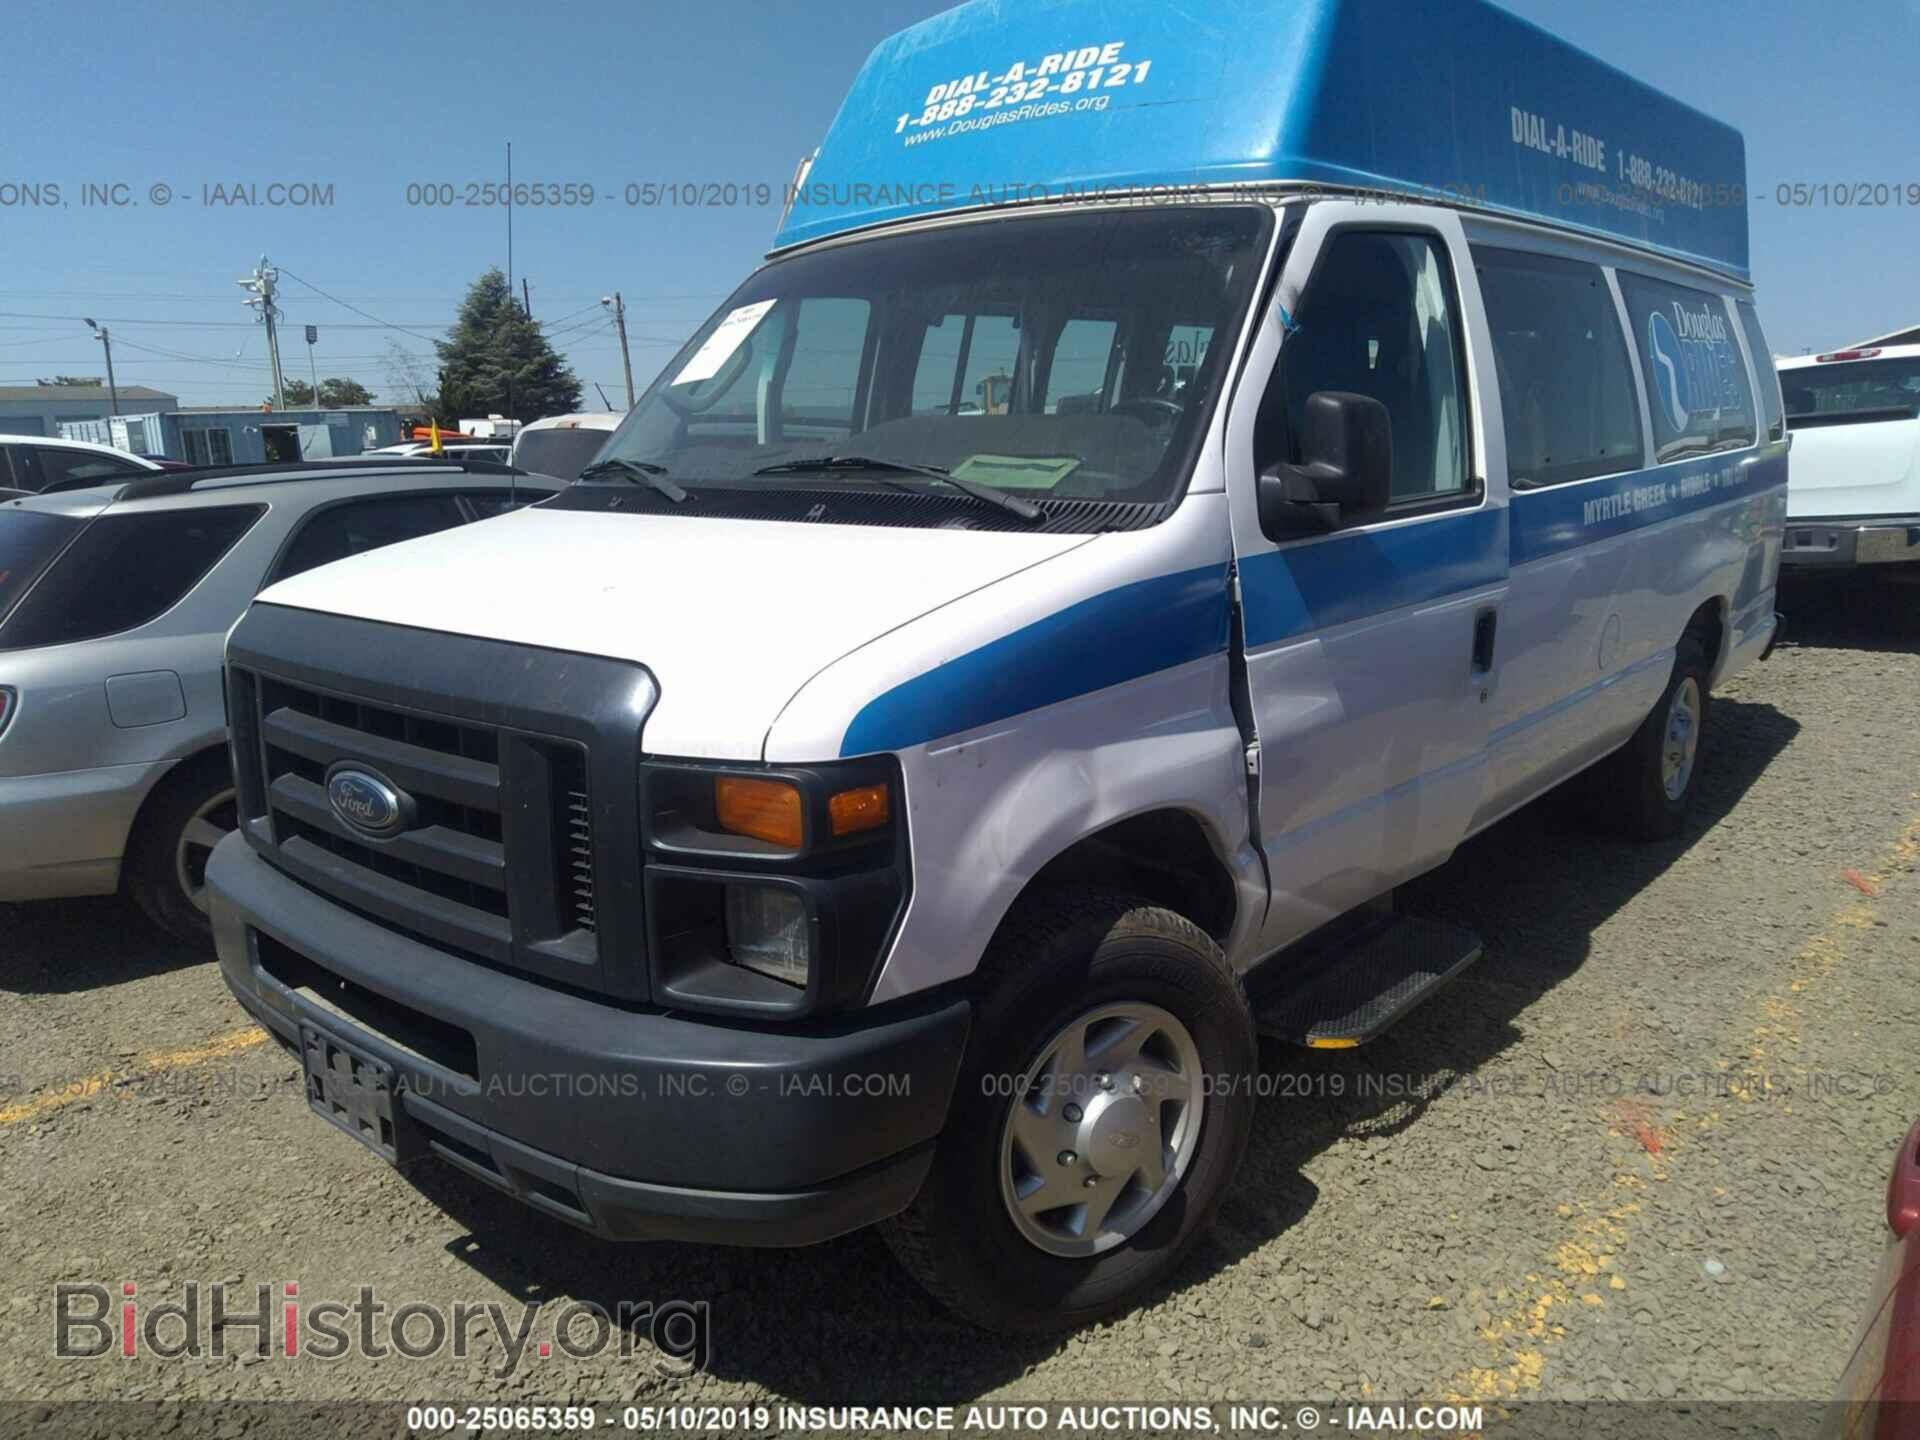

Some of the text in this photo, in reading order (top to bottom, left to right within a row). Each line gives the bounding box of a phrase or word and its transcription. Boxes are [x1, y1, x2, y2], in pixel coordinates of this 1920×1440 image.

[894, 60, 1153, 134] 1-888-232-8121
[924, 41, 1125, 106] DIAL-A-RIDE
[904, 95, 1111, 147] www.DouglasRides.org
[1510, 106, 1606, 172] DIAL-A-RIDE
[1671, 301, 1728, 350] Douglas
[1583, 492, 1632, 526] MYRTLE
